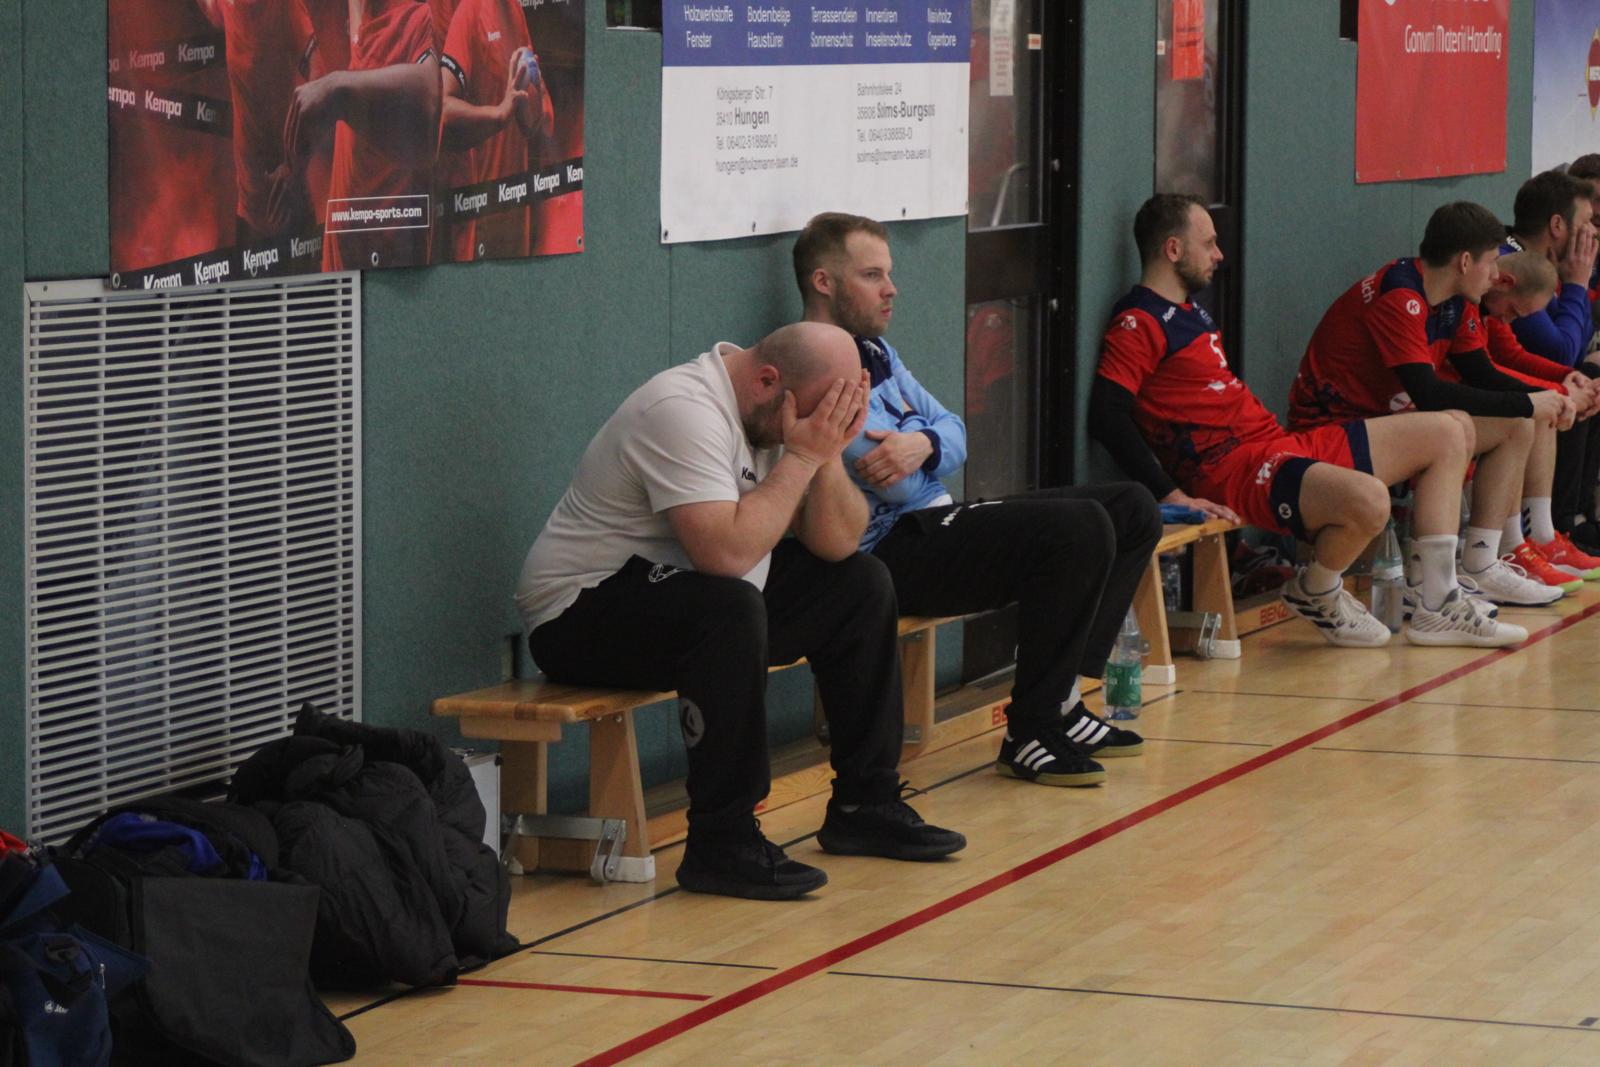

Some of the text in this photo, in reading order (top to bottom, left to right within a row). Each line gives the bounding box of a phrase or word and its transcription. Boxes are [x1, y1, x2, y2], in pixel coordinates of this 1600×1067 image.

[686, 31, 712, 48] Fenster
[129, 50, 165, 71] Kempa
[178, 44, 215, 65] Kempa
[145, 90, 182, 120] Kempa
[734, 107, 770, 129] Hungen
[454, 192, 488, 214] Kempa
[498, 183, 527, 203] Kempa
[533, 173, 560, 193] Kempa
[331, 207, 422, 224] www.kempa-sports.com
[194, 260, 230, 286] Kempa
[243, 248, 279, 271] Kempa
